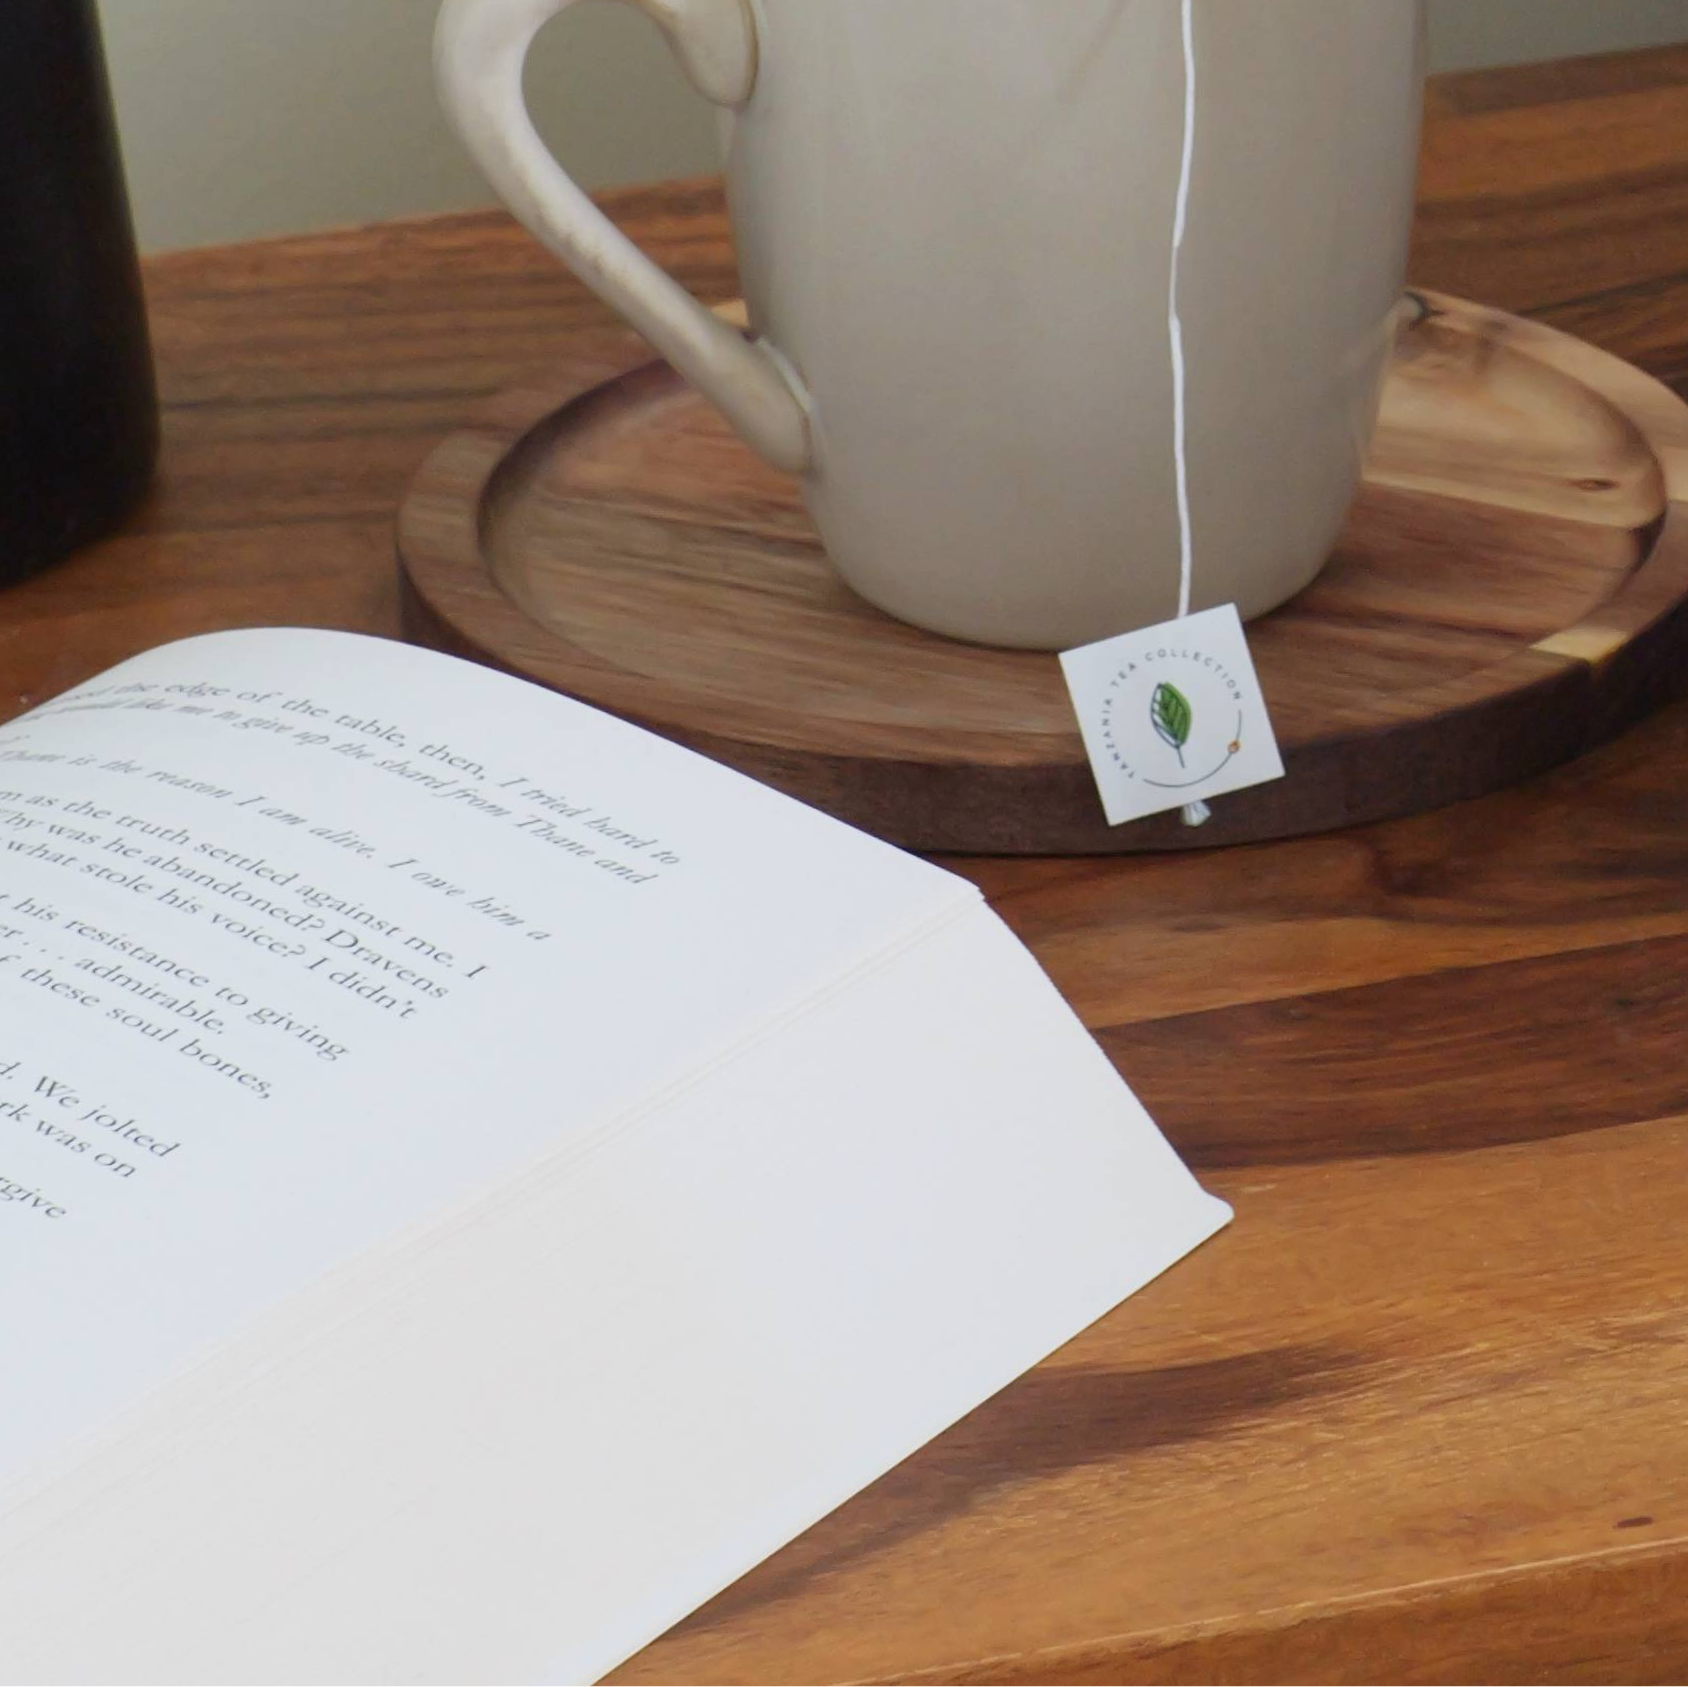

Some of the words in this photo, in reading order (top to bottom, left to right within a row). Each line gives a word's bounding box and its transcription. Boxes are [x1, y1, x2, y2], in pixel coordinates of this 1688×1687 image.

[1110, 662, 1137, 689] TEA
[1144, 648, 1243, 701] COLLECTION
[99, 759, 143, 774] the
[145, 770, 234, 799] reason
[234, 795, 267, 806] I
[257, 808, 308, 825] am
[308, 830, 376, 859] alive.
[386, 858, 420, 869] I
[411, 871, 466, 897] owe
[466, 896, 525, 926] him
[526, 930, 552, 940] a
[231, 716, 295, 734] give
[292, 730, 330, 745] up
[331, 742, 376, 760] the
[373, 759, 459, 790] shard
[431, 786, 512, 817] from
[515, 814, 595, 857] Thane
[594, 858, 659, 884] and
[236, 690, 284, 703] of
[281, 699, 330, 717] the
[334, 714, 406, 747] table,
[418, 743, 485, 781] then,
[499, 777, 529, 788] I
[520, 789, 592, 818] tried
[583, 816, 658, 849] hard
[650, 849, 681, 864] to
[6, 838, 79, 867] what
[79, 863, 154, 895] stole
[156, 888, 204, 915] his
[209, 911, 307, 958] voice?
[305, 957, 331, 971] I
[328, 970, 419, 1020] didn't
[25, 794, 60, 807] as
[62, 800, 111, 820] the
[115, 814, 191, 847] truth
[193, 841, 300, 888] settled
[294, 884, 404, 937] against
[403, 936, 455, 968] me.
[463, 965, 490, 979] I
[48, 823, 102, 845] was
[102, 837, 144, 859] he
[143, 855, 326, 932] abandoned?
[322, 928, 450, 1000] Dravens
[12, 897, 60, 922] his
[64, 920, 210, 988] resistance
[214, 986, 250, 1008] to
[245, 1006, 350, 1062] giving
[20, 967, 101, 1007] these
[105, 1007, 180, 1043] soul
[179, 1038, 273, 1100] bones,
[74, 957, 224, 1035] admirable.
[34, 1075, 81, 1108] We
[78, 1104, 182, 1157] jolted
[35, 1120, 92, 1153] was
[94, 1152, 137, 1179] on
